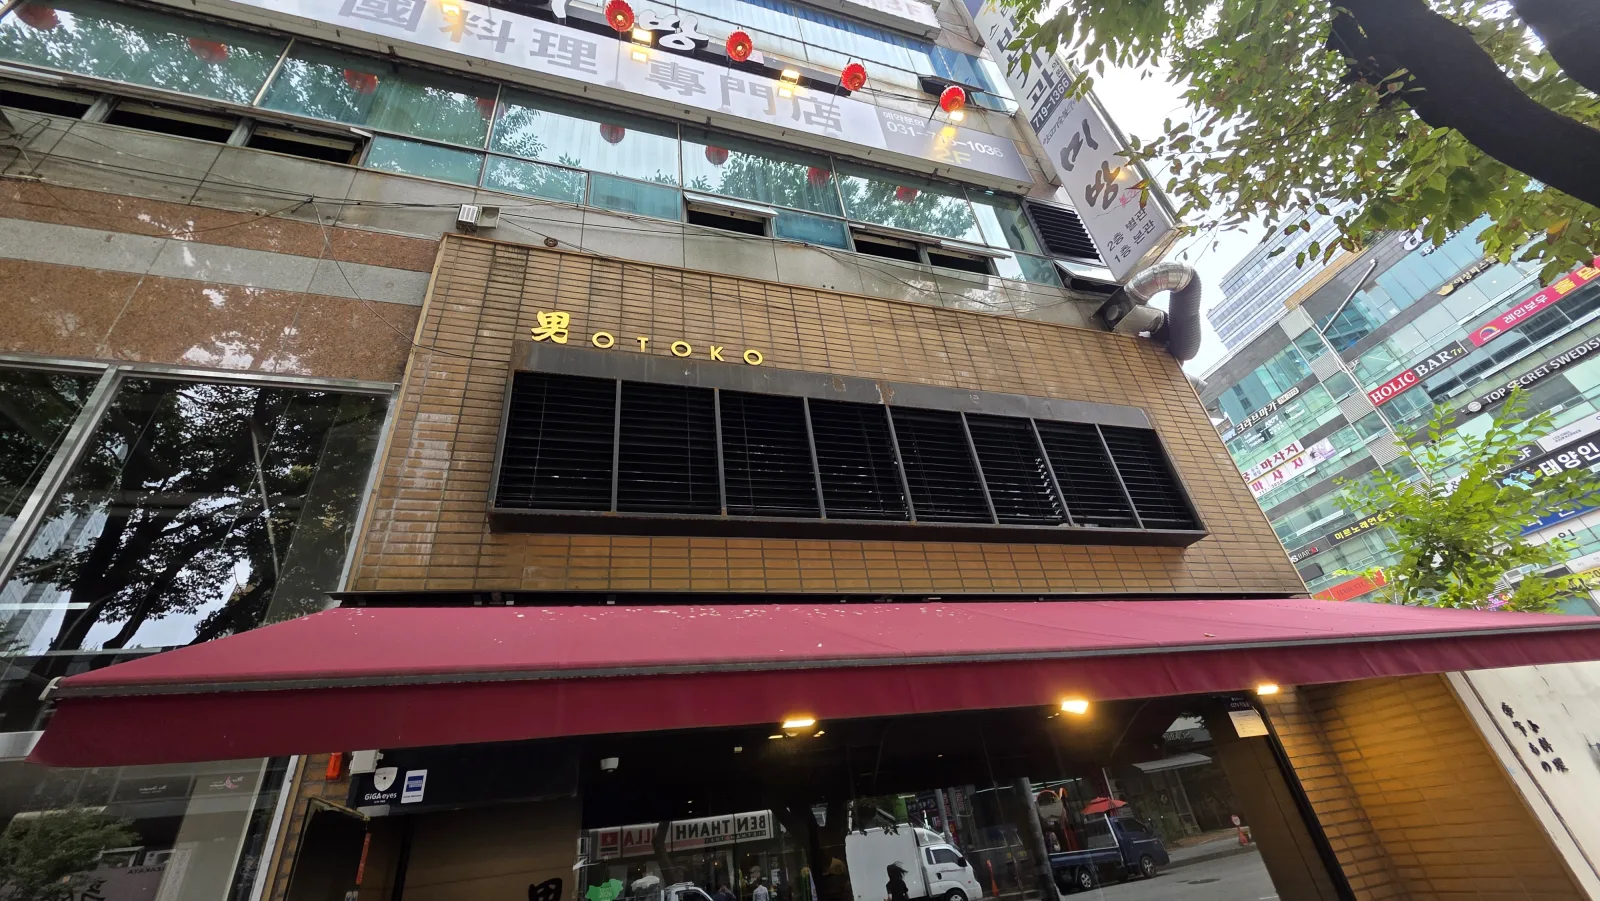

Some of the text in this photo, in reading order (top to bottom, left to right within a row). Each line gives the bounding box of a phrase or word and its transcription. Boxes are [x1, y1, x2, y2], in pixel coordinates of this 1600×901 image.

[882, 111, 925, 128] 예약문의
[1032, 77, 1070, 129] 719-1366
[936, 149, 971, 165] 2F
[1107, 207, 1148, 252] 2층 별관
[1114, 219, 1155, 263] 1층 본관
[1502, 293, 1549, 324] 레인보우
[531, 310, 764, 366] 男 OTOKO
[1370, 370, 1416, 404] HOLIC
[1414, 349, 1454, 377] BAR
[1484, 388, 1506, 404] TOP
[1507, 361, 1550, 393] SECRET
[1236, 400, 1278, 434] 크라브마가
[1260, 443, 1299, 470] 마사지
